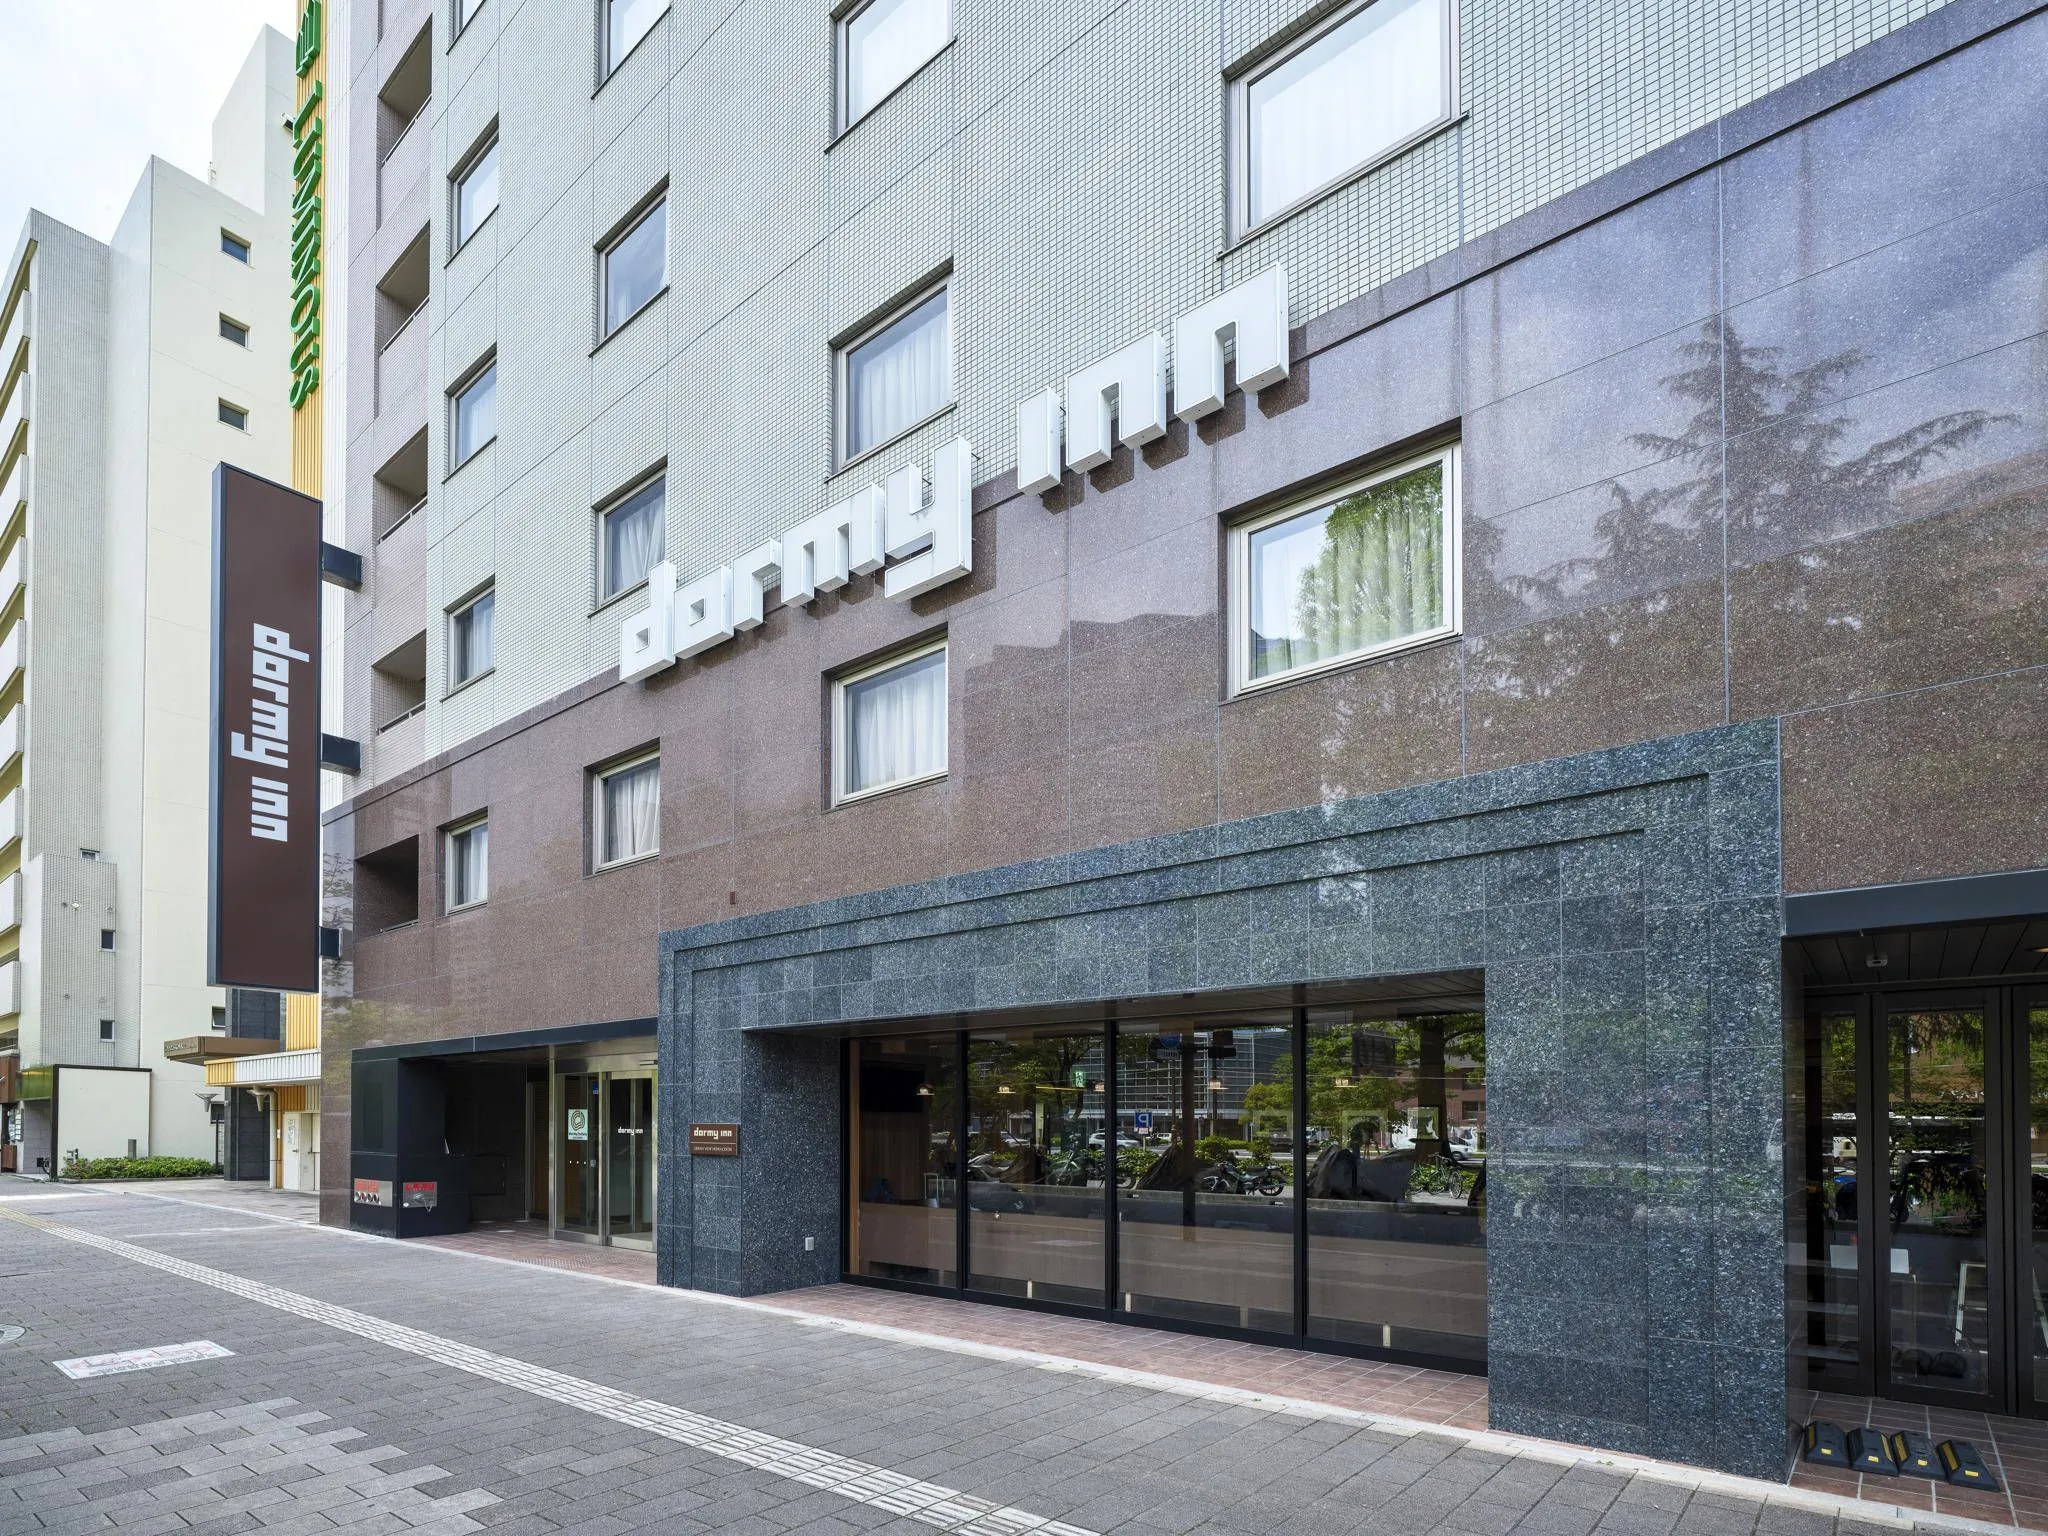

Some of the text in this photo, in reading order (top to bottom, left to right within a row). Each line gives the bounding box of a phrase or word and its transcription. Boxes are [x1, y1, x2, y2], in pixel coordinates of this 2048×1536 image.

[289, 80, 322, 410] LUMINOUS
[619, 261, 1289, 684] dormy inn
[231, 623, 309, 842] dormy inn
[617, 1126, 635, 1135] dormy
[693, 1127, 719, 1140] dormy
